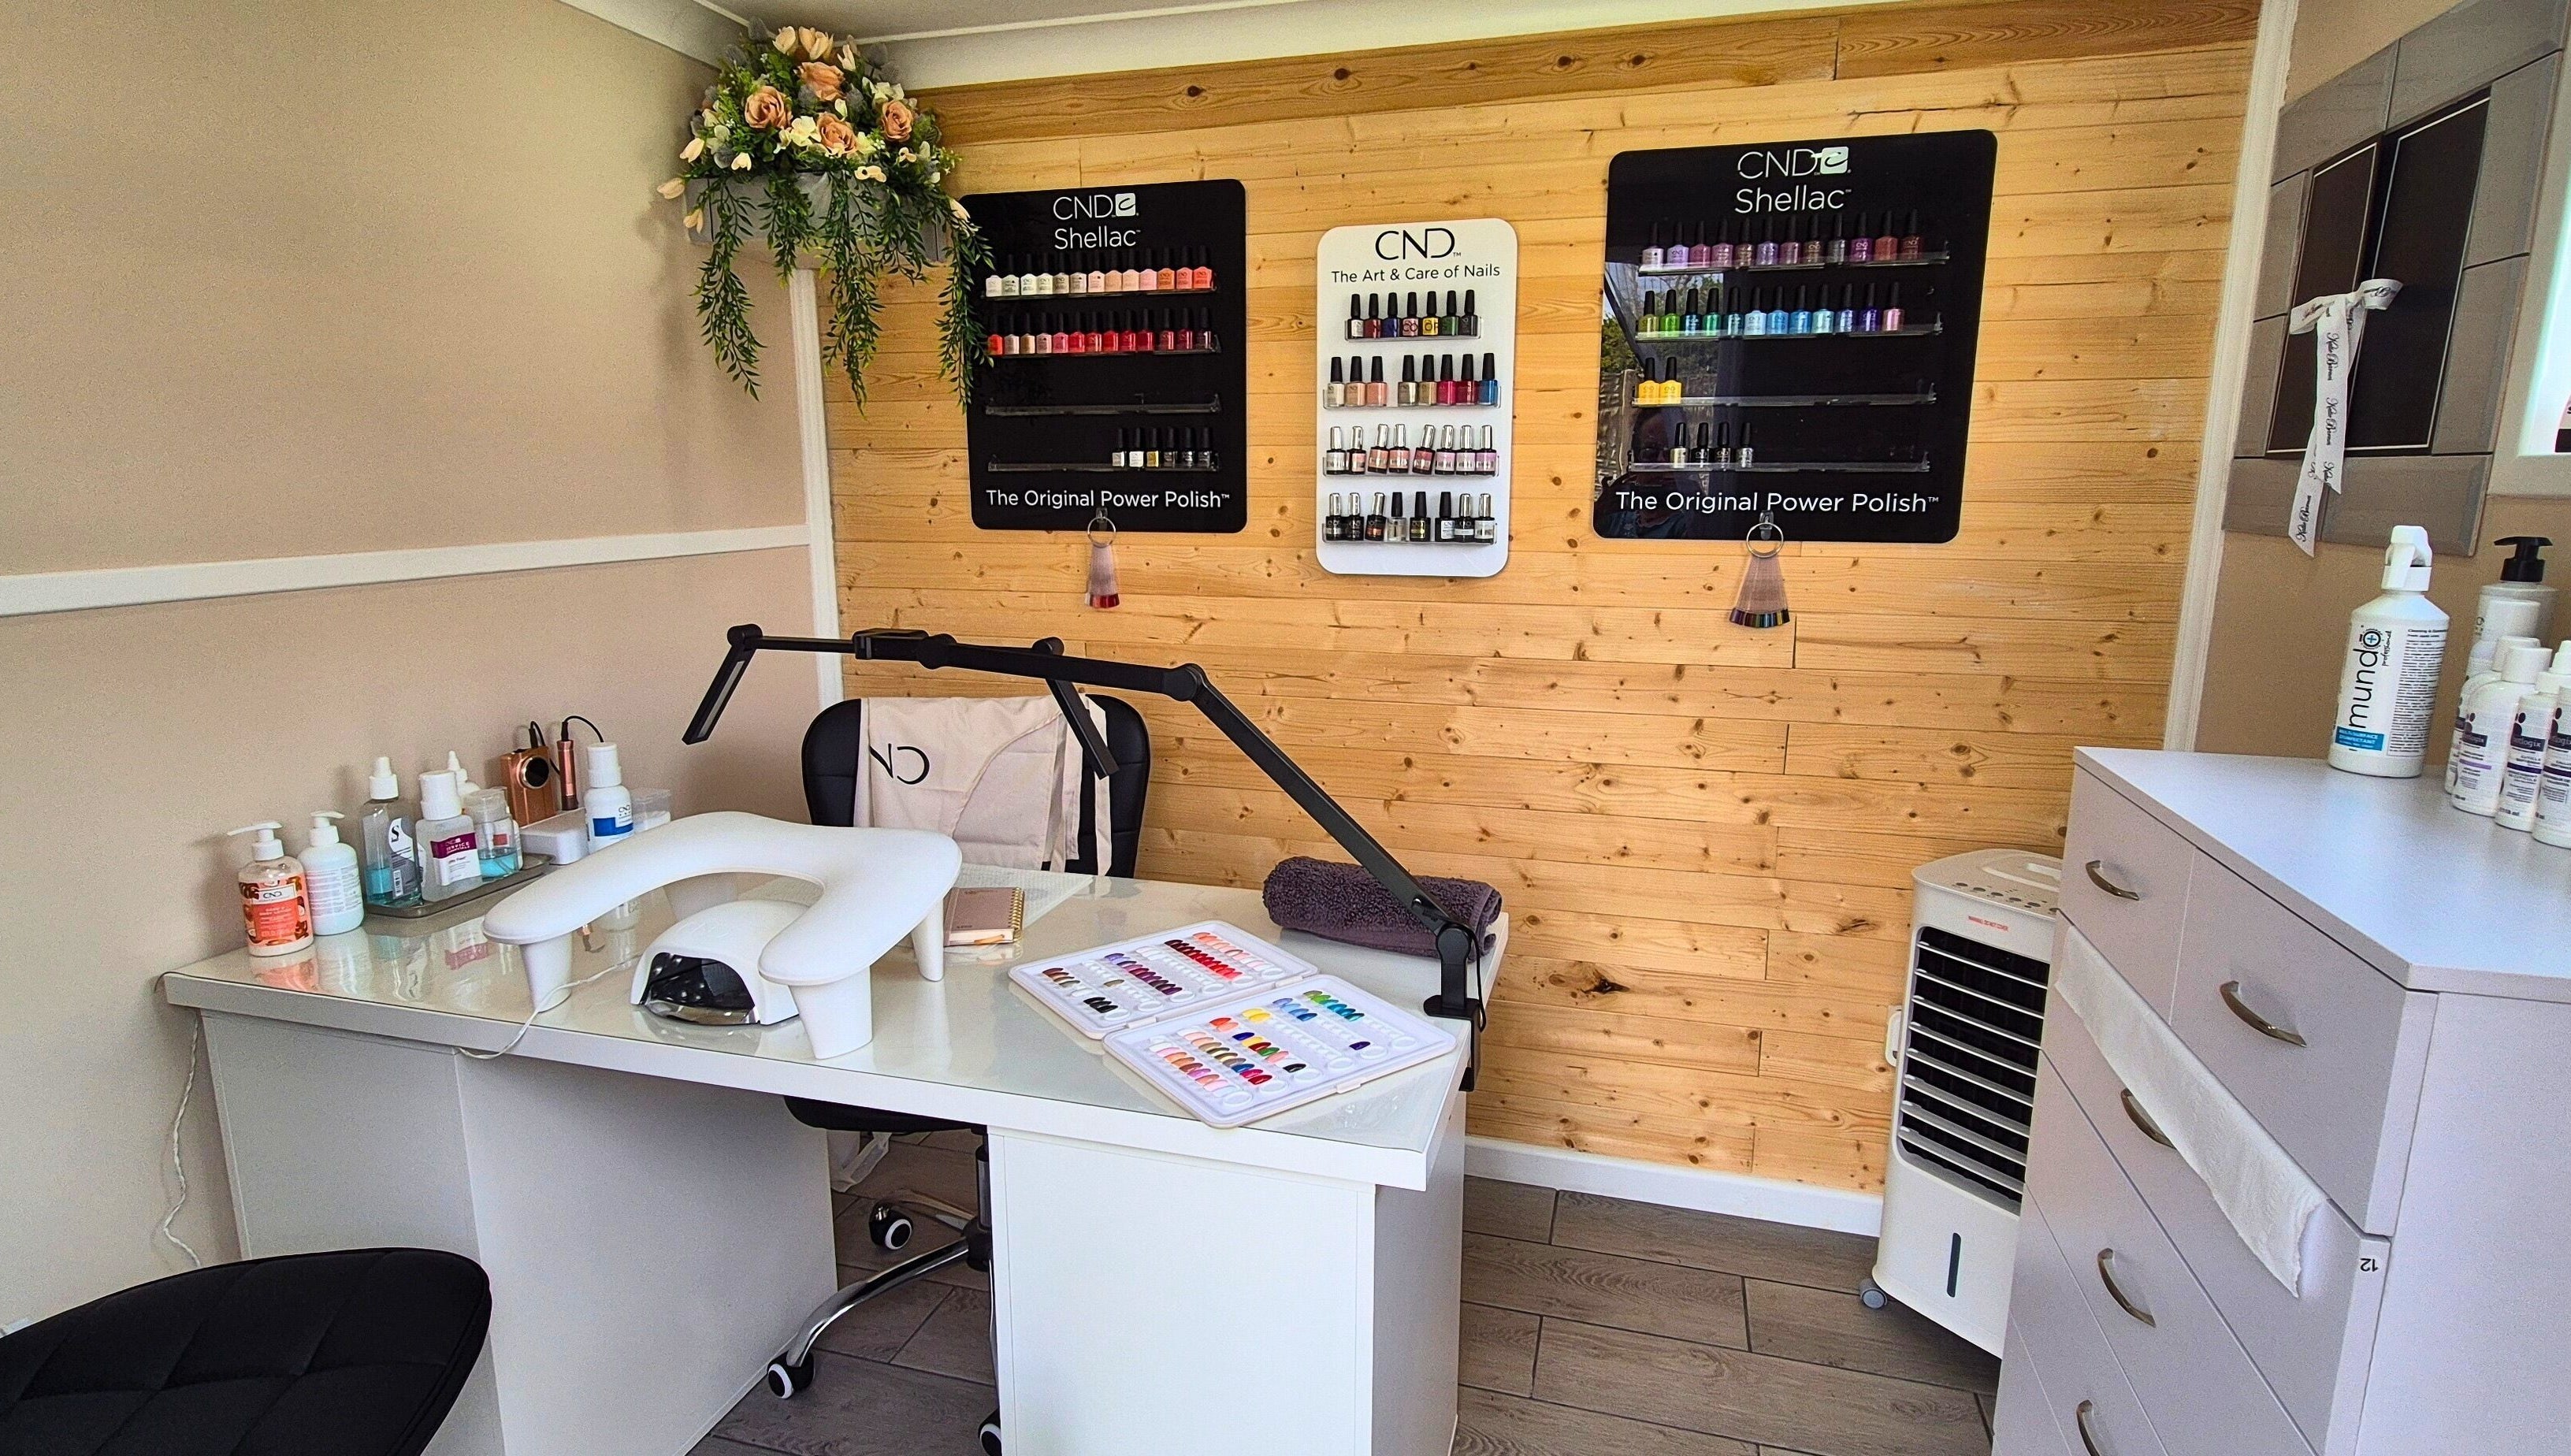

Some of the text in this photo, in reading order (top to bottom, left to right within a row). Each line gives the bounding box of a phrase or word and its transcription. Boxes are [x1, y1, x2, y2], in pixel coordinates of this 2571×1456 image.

[1332, 263, 1500, 283] The Art & Care of Nails
[985, 489, 1019, 506] The
[1024, 489, 1094, 509] Original
[1101, 490, 1158, 507] Power
[1616, 492, 1658, 510] The
[1666, 492, 1758, 513] Original
[1767, 492, 1845, 511] Power
[2360, 1257, 2379, 1272] 12
